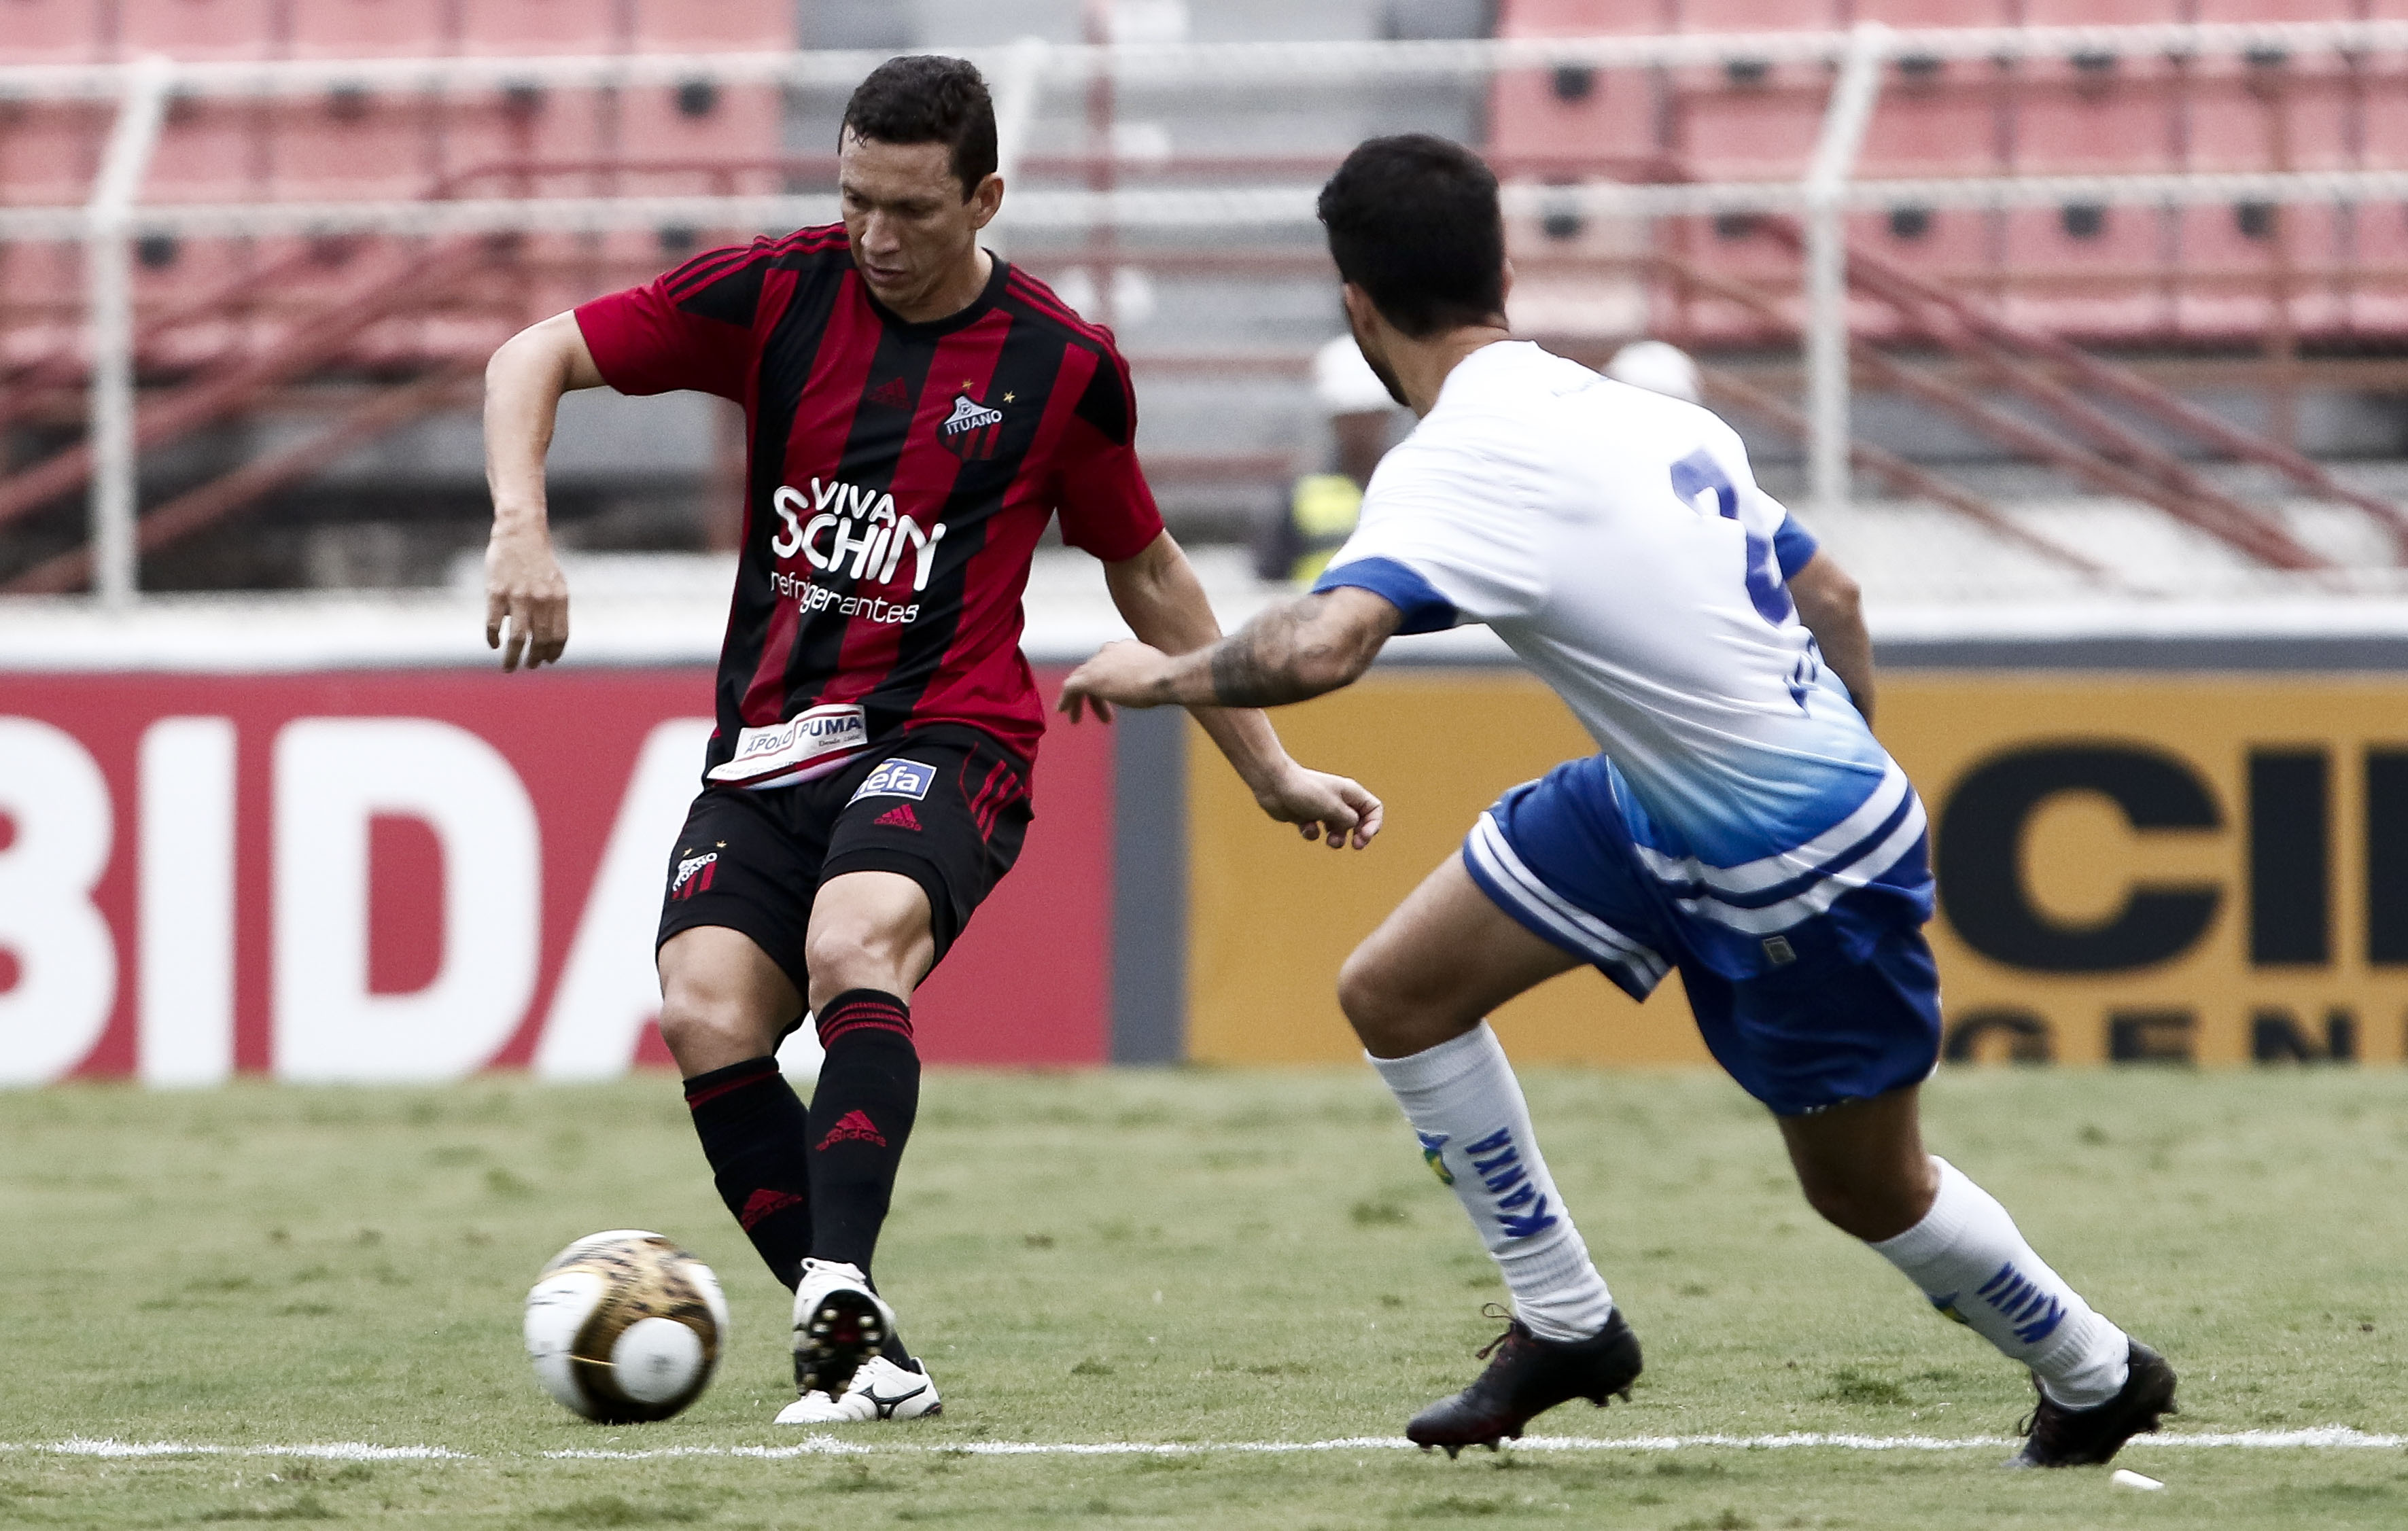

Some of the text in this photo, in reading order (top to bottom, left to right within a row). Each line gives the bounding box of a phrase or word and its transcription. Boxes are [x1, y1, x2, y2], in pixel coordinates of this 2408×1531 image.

[946, 410, 1002, 435] ITUANO
[811, 477, 896, 528] VIVA
[772, 485, 947, 591] SCHIN
[771, 571, 920, 623] refrigerantes
[745, 716, 863, 754] APOLO PUMA
